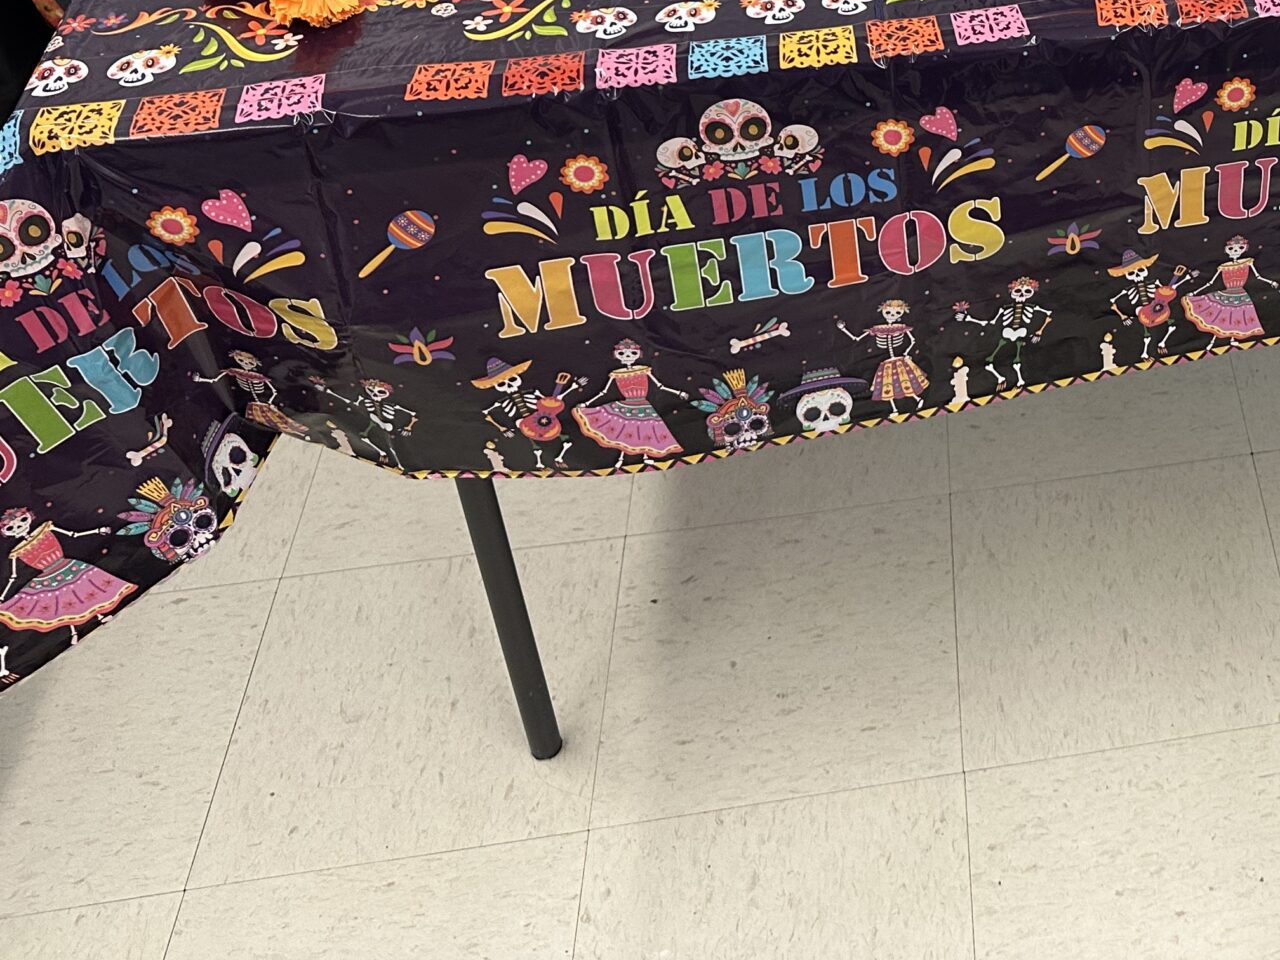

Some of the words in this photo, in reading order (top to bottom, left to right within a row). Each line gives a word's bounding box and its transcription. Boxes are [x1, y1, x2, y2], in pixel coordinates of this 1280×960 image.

[589, 190, 696, 241] DÍA
[707, 182, 784, 225] DE
[797, 167, 898, 213] LOS
[15, 288, 111, 354] DE
[484, 196, 1006, 339] MUERTOS
[0, 276, 339, 485] ERTOS
